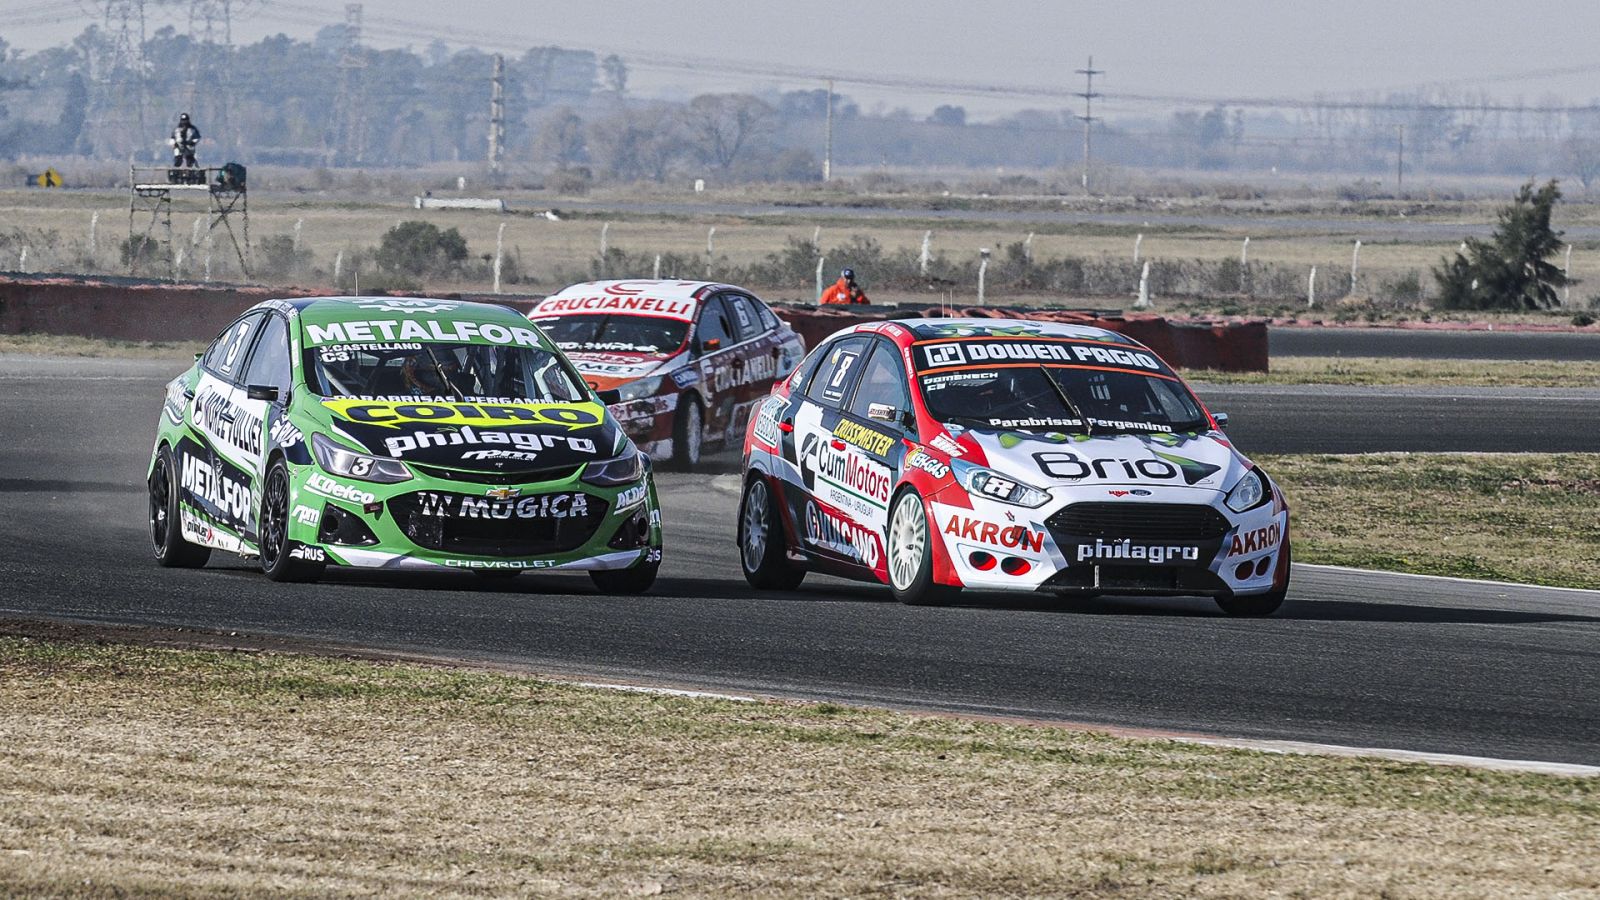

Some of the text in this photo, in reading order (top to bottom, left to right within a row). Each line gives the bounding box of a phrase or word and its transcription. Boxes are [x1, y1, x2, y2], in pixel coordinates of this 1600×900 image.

[539, 297, 691, 314] CRUCIANELLI
[226, 323, 250, 367] 3
[306, 320, 541, 348] METALFOR
[320, 343, 422, 353] J.CASTELLANO
[321, 351, 350, 363] C3
[966, 343, 1159, 369] DOWEN PAGIO
[831, 355, 854, 387] 8
[346, 405, 599, 423] COIRO
[989, 417, 1172, 432] Parabrisas Pergamino
[385, 426, 596, 457] philagro
[833, 419, 893, 457] CROSSMASTER
[351, 457, 370, 475] 3
[461, 450, 537, 460] rpm
[818, 441, 889, 502] CumMotors
[181, 452, 250, 525] METALFOR
[305, 472, 375, 503] ACDelco
[984, 476, 1017, 498] 8
[291, 505, 320, 524] rpm
[944, 514, 1044, 553] AKRON
[1228, 521, 1280, 557] AKRON
[304, 547, 325, 561] RUS
[1077, 538, 1199, 563] philagro
[445, 559, 555, 569] CHEVROLET
